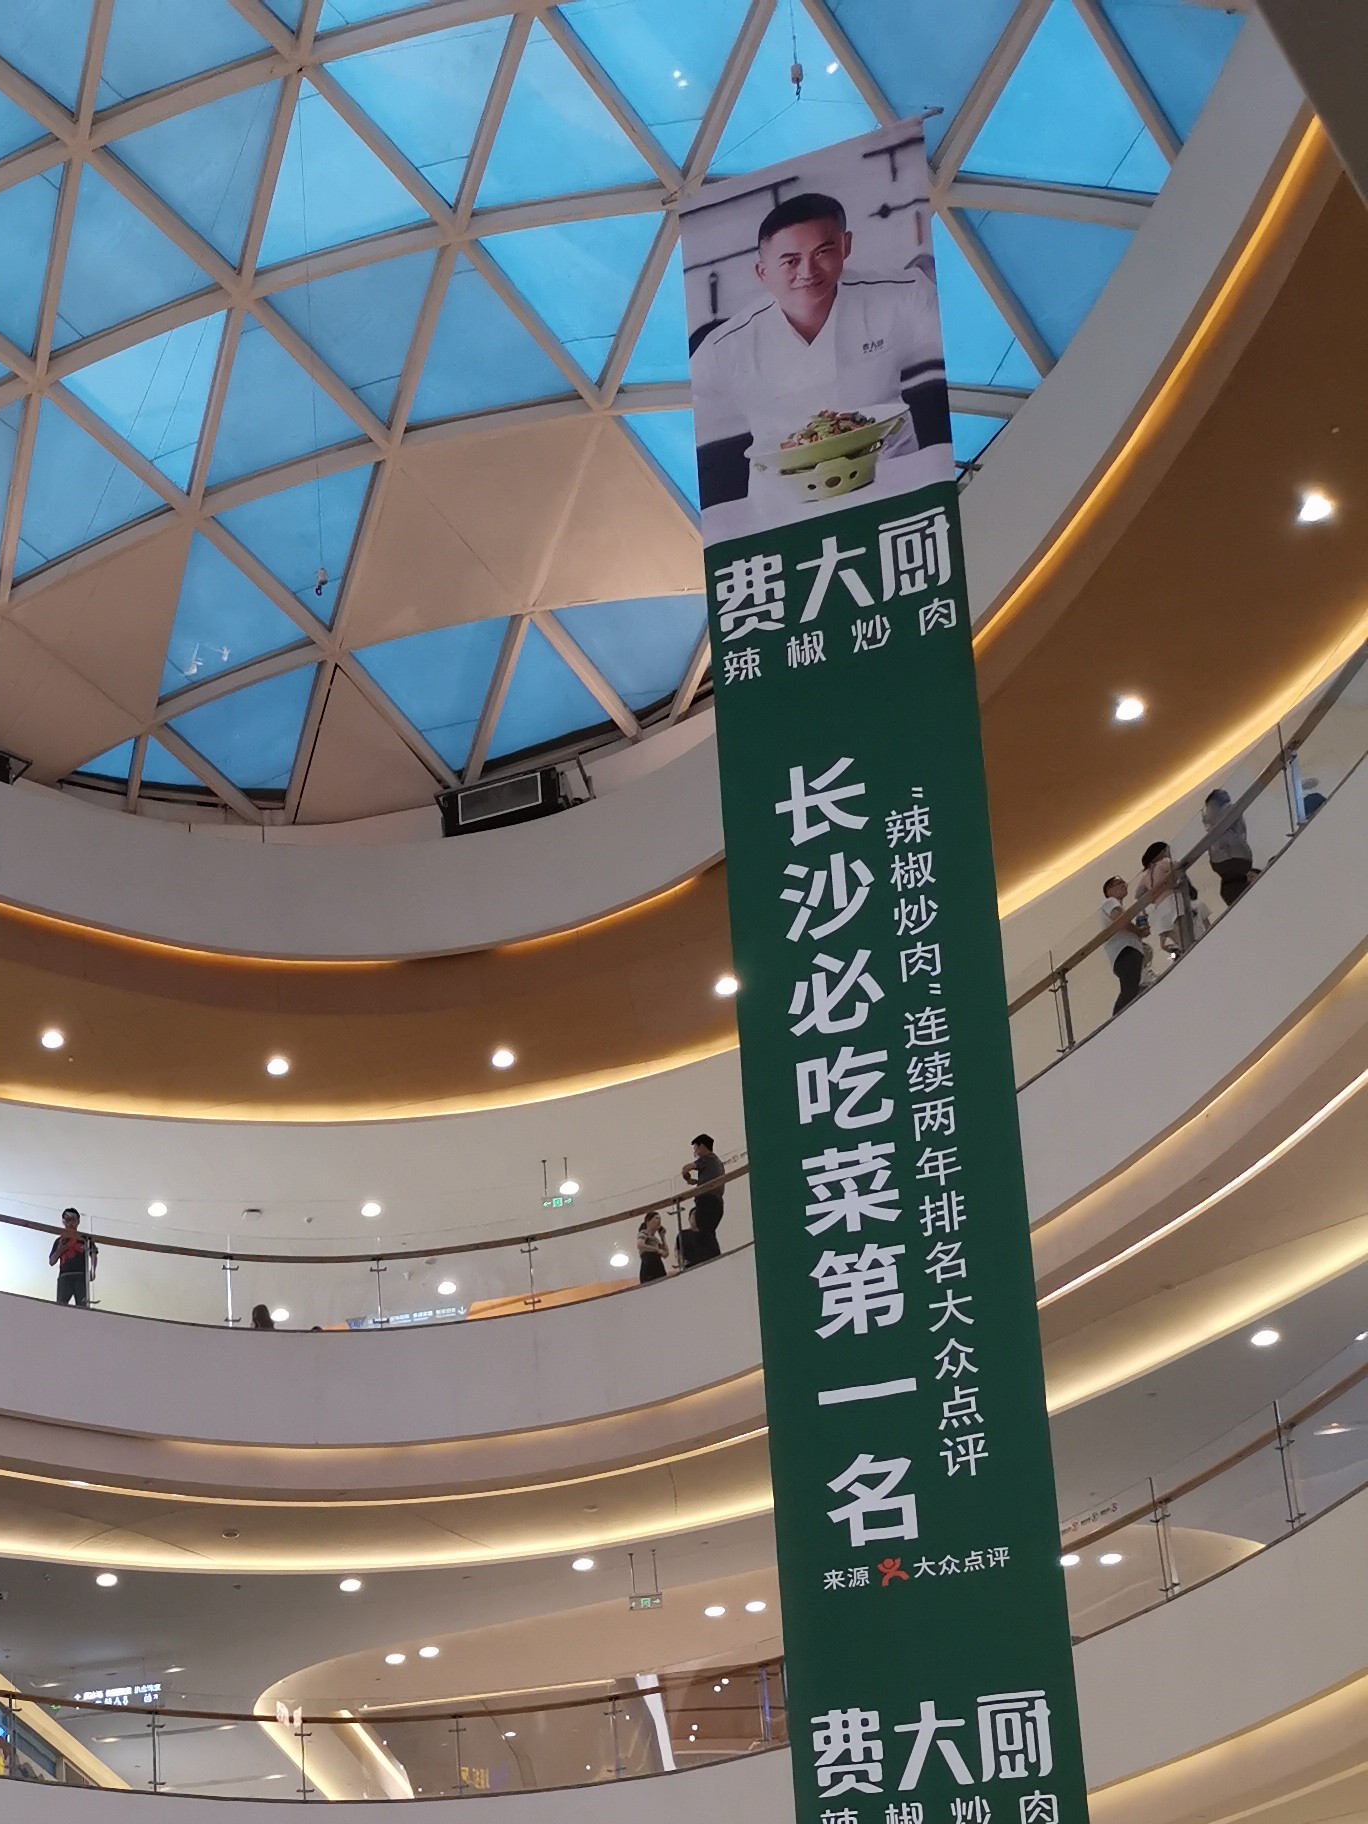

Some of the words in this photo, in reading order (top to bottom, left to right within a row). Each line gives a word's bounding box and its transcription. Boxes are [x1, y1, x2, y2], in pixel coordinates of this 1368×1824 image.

[715, 507, 952, 642] 费大厨
[722, 597, 957, 686] 辣椒炒肉
[774, 757, 919, 1548] 长沙必吃菜第一名
[823, 1566, 870, 1590] 来源
[913, 1546, 1011, 1578] 大众点评
[810, 1689, 1053, 1798] 费大厨
